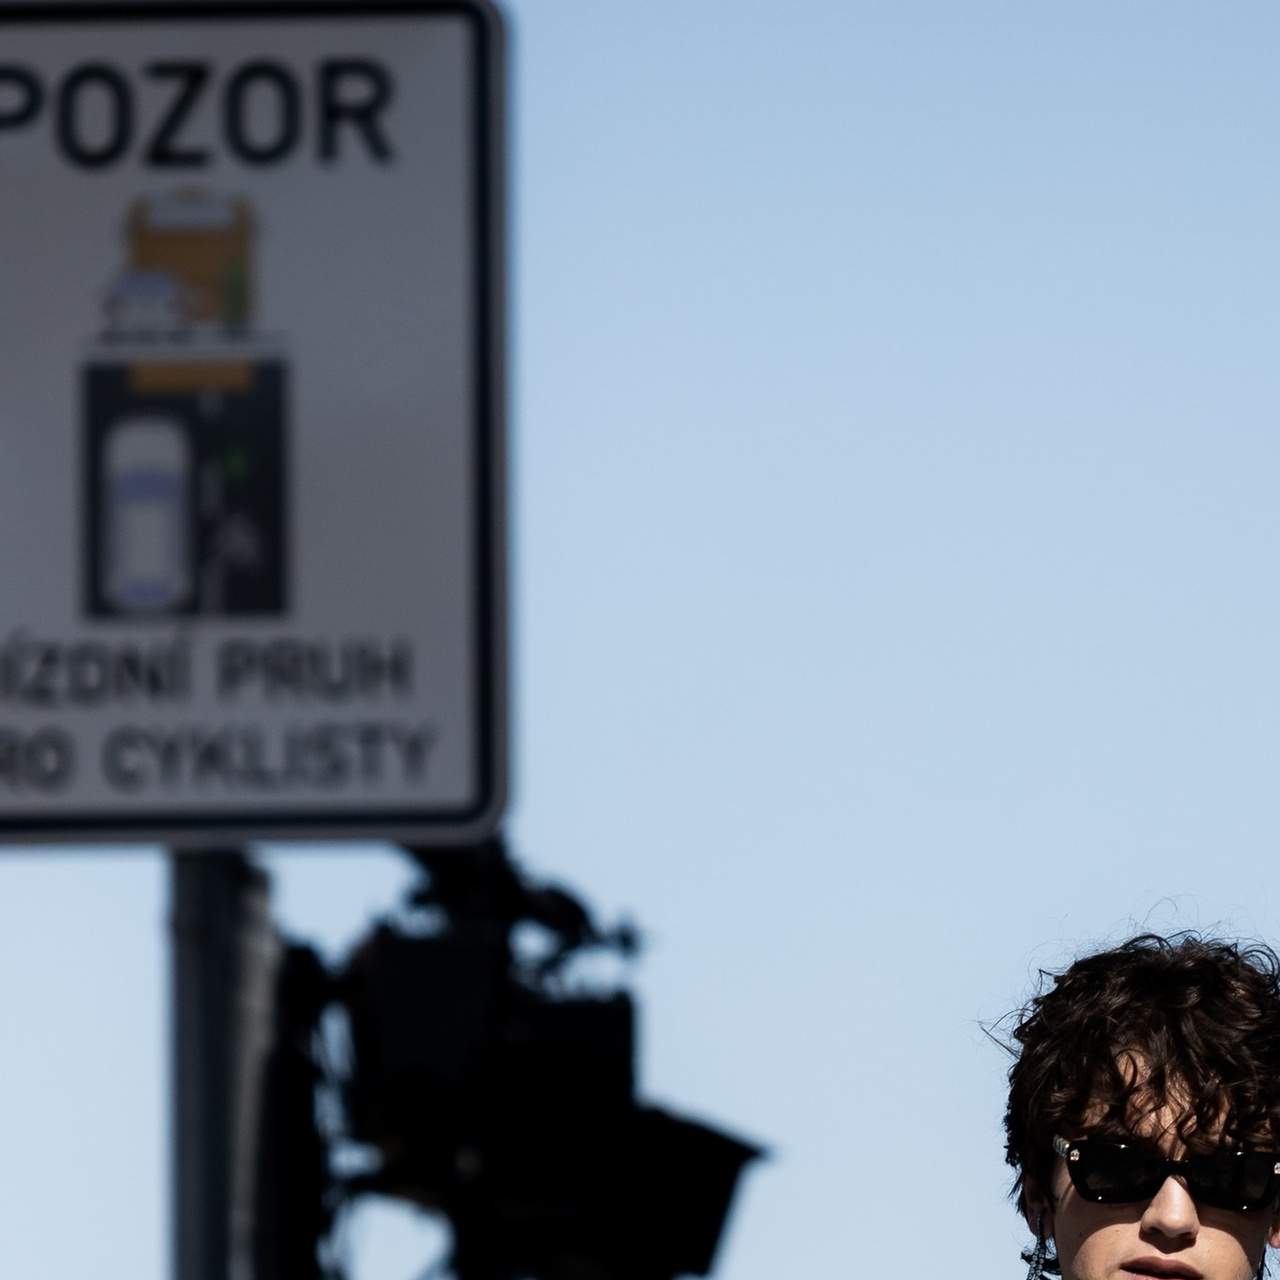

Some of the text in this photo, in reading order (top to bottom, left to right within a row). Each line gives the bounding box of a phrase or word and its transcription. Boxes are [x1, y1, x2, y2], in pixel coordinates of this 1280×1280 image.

[0, 58, 394, 168] POZOR
[216, 638, 412, 704] PRUH
[101, 721, 438, 791] CYKLISTY
